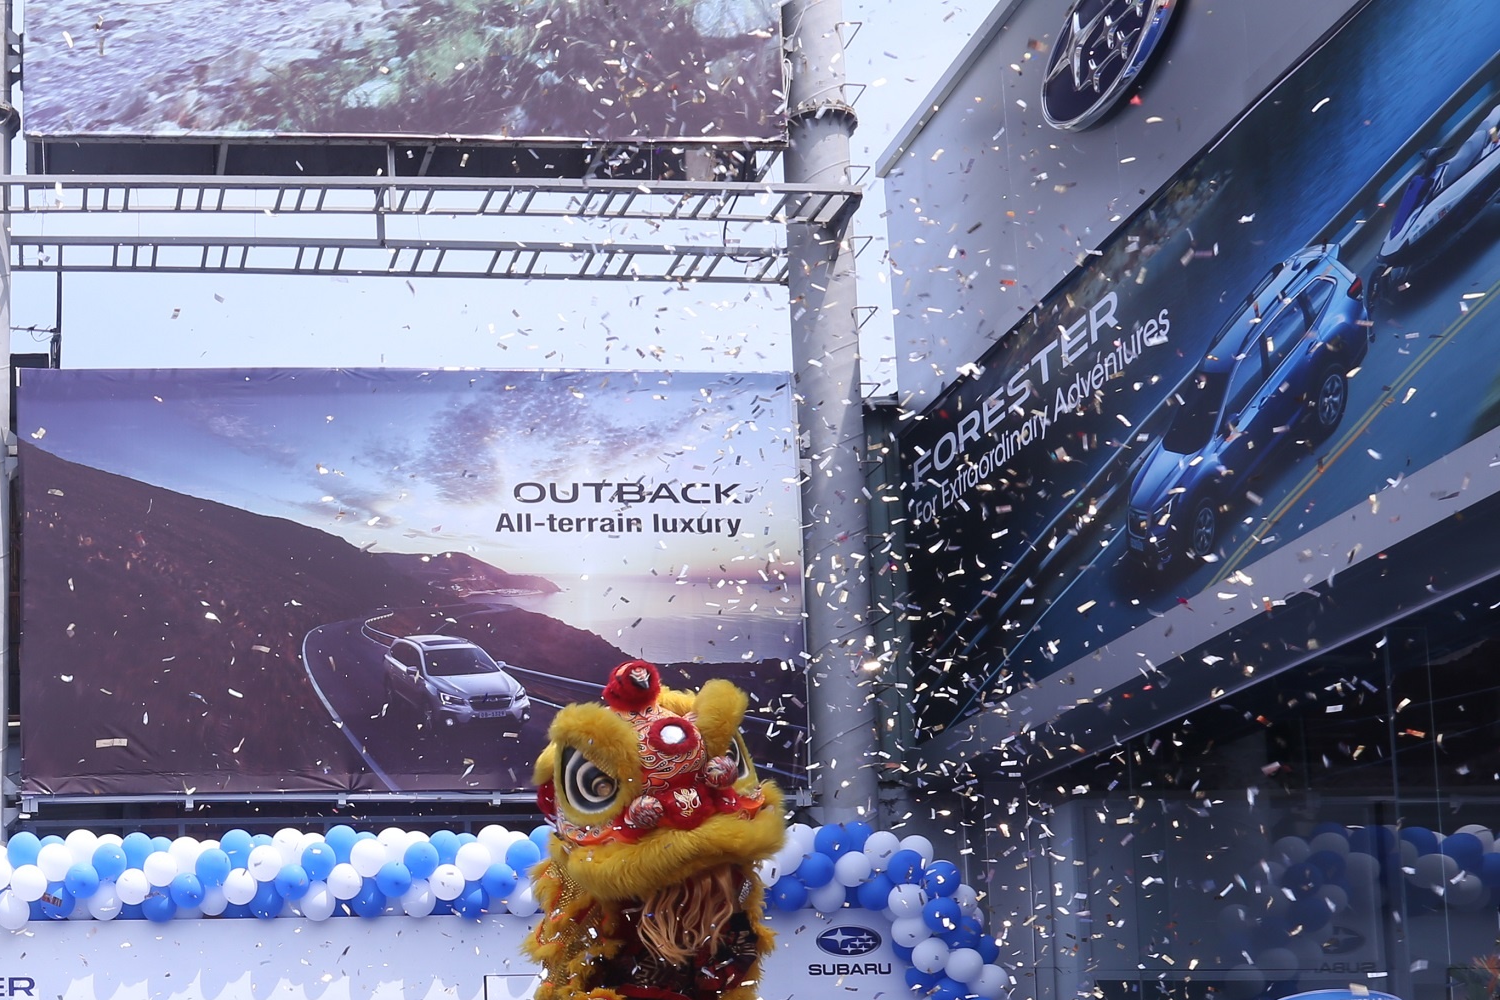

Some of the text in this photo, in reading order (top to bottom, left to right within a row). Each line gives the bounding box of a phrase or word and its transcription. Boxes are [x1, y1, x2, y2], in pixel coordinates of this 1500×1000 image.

[912, 290, 1119, 492] FORESTER
[914, 307, 1171, 524] For Extraordinary Adventures
[513, 481, 743, 505] OUTBACK
[495, 512, 742, 538] All-terrain luxury
[807, 962, 892, 976] SUBARU
